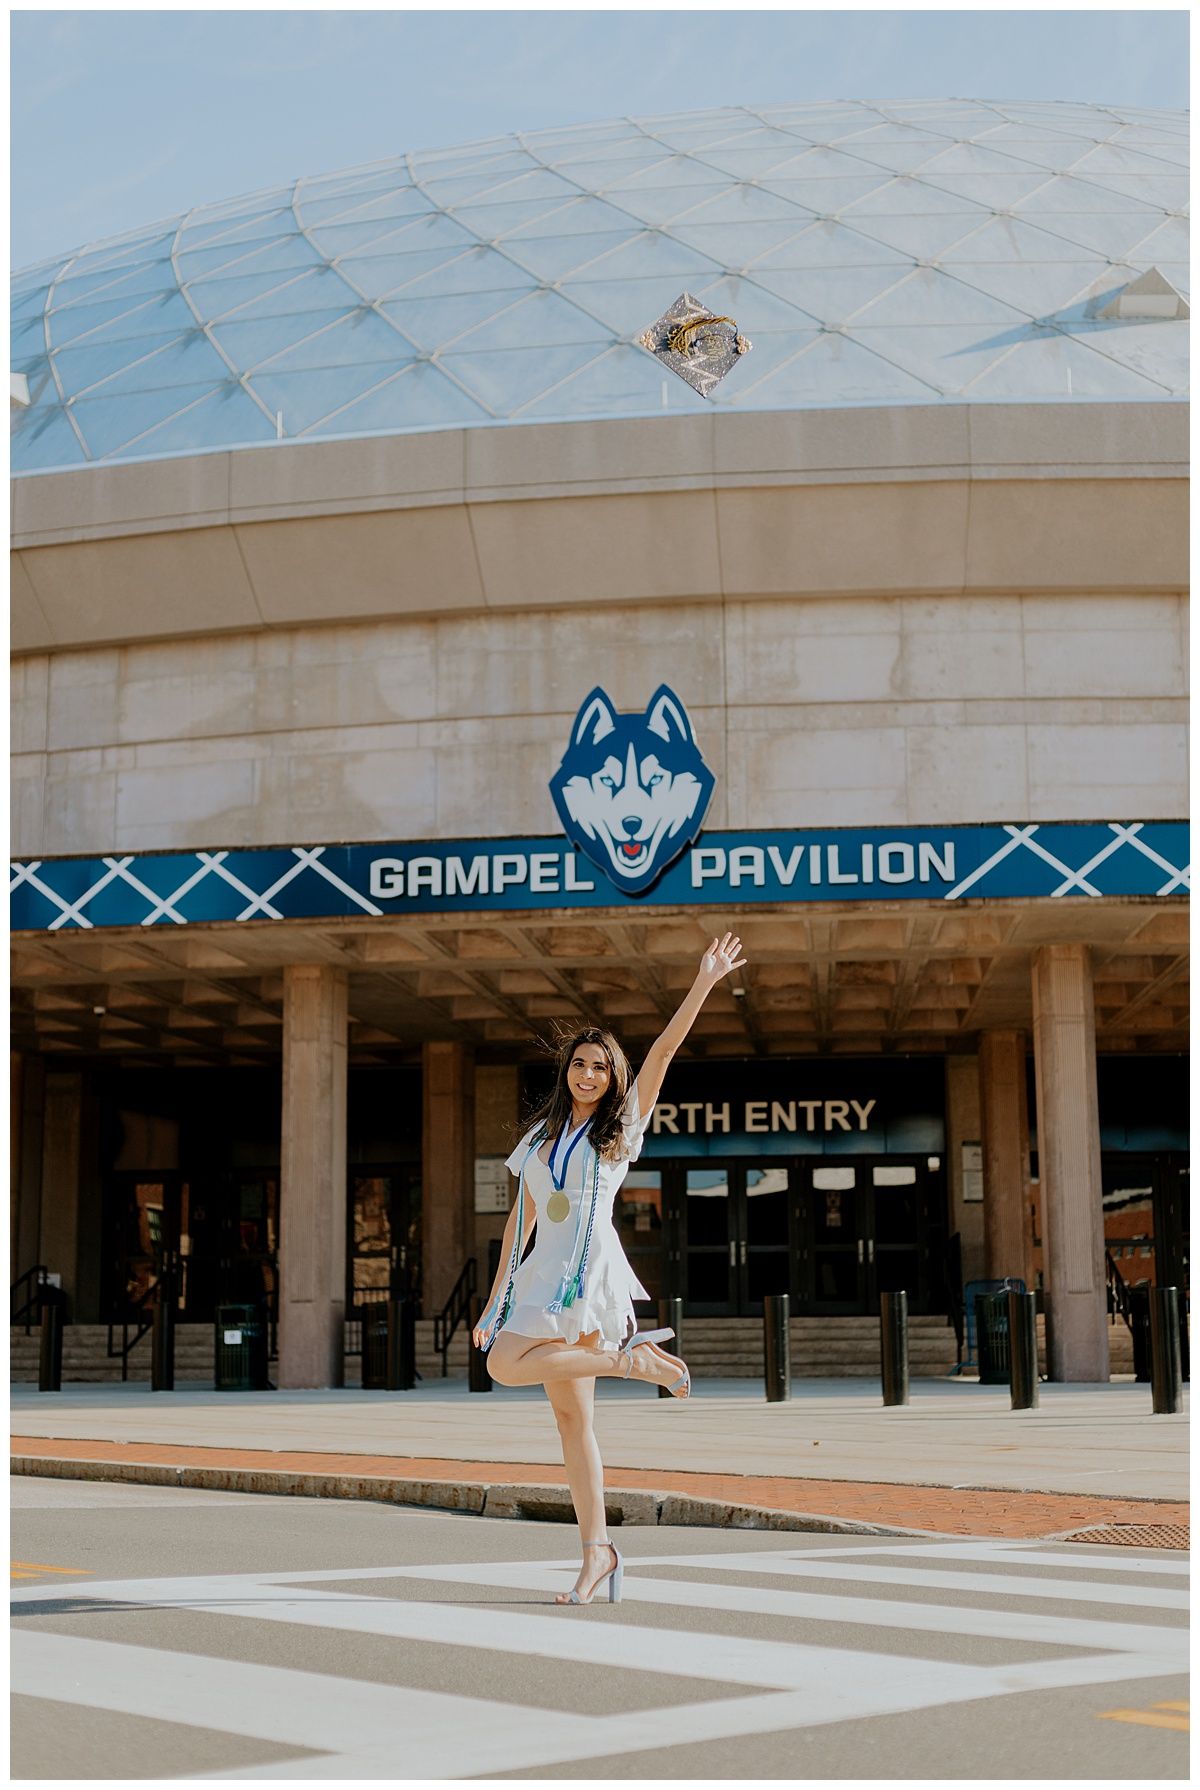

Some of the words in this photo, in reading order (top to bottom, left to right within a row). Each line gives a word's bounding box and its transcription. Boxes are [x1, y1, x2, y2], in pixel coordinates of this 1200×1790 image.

[369, 852, 595, 899] GAMPEL
[690, 841, 956, 888] PAVILION
[648, 1102, 731, 1134] RTH
[744, 1099, 877, 1133] ENTRY
